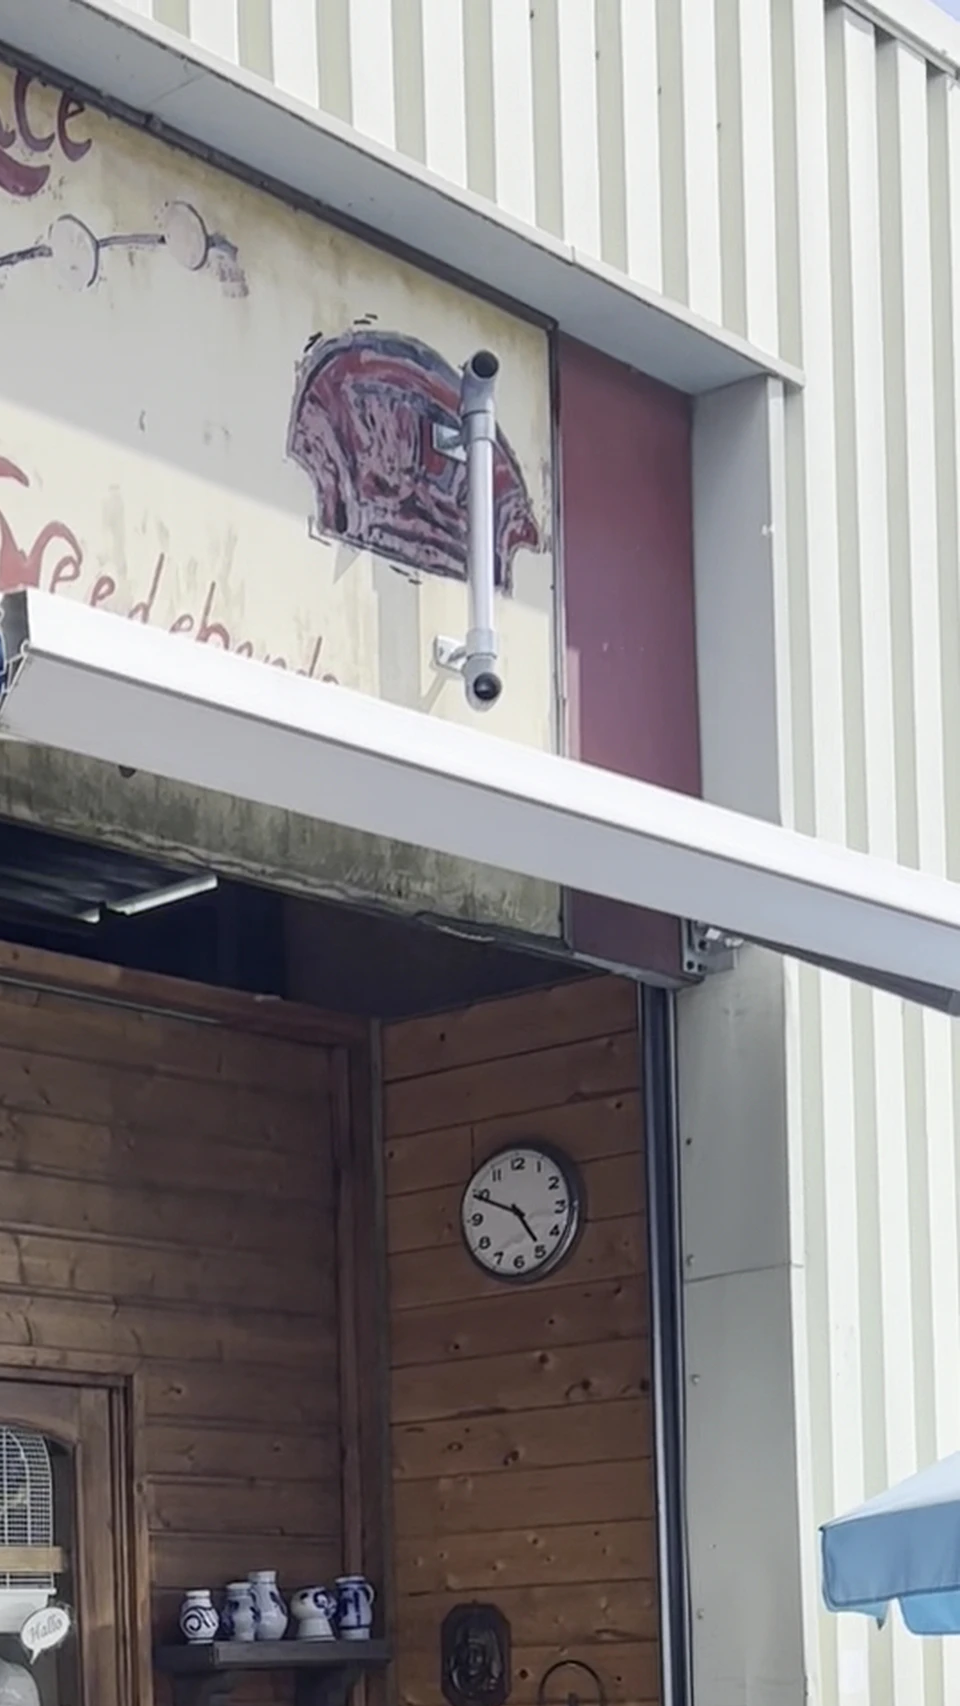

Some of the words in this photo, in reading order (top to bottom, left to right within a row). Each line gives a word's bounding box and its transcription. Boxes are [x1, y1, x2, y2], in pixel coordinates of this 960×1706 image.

[511, 1157, 525, 1171] 12
[492, 1169, 502, 1182] 11
[548, 1176, 560, 1190] 2
[554, 1200, 566, 1214] 3
[471, 1213, 484, 1226] 9
[549, 1224, 560, 1236] 4
[479, 1236, 491, 1250] 8
[493, 1251, 504, 1265] 7
[535, 1245, 546, 1259] 5
[513, 1255, 525, 1269] 6
[25, 1613, 63, 1643] Hallo
